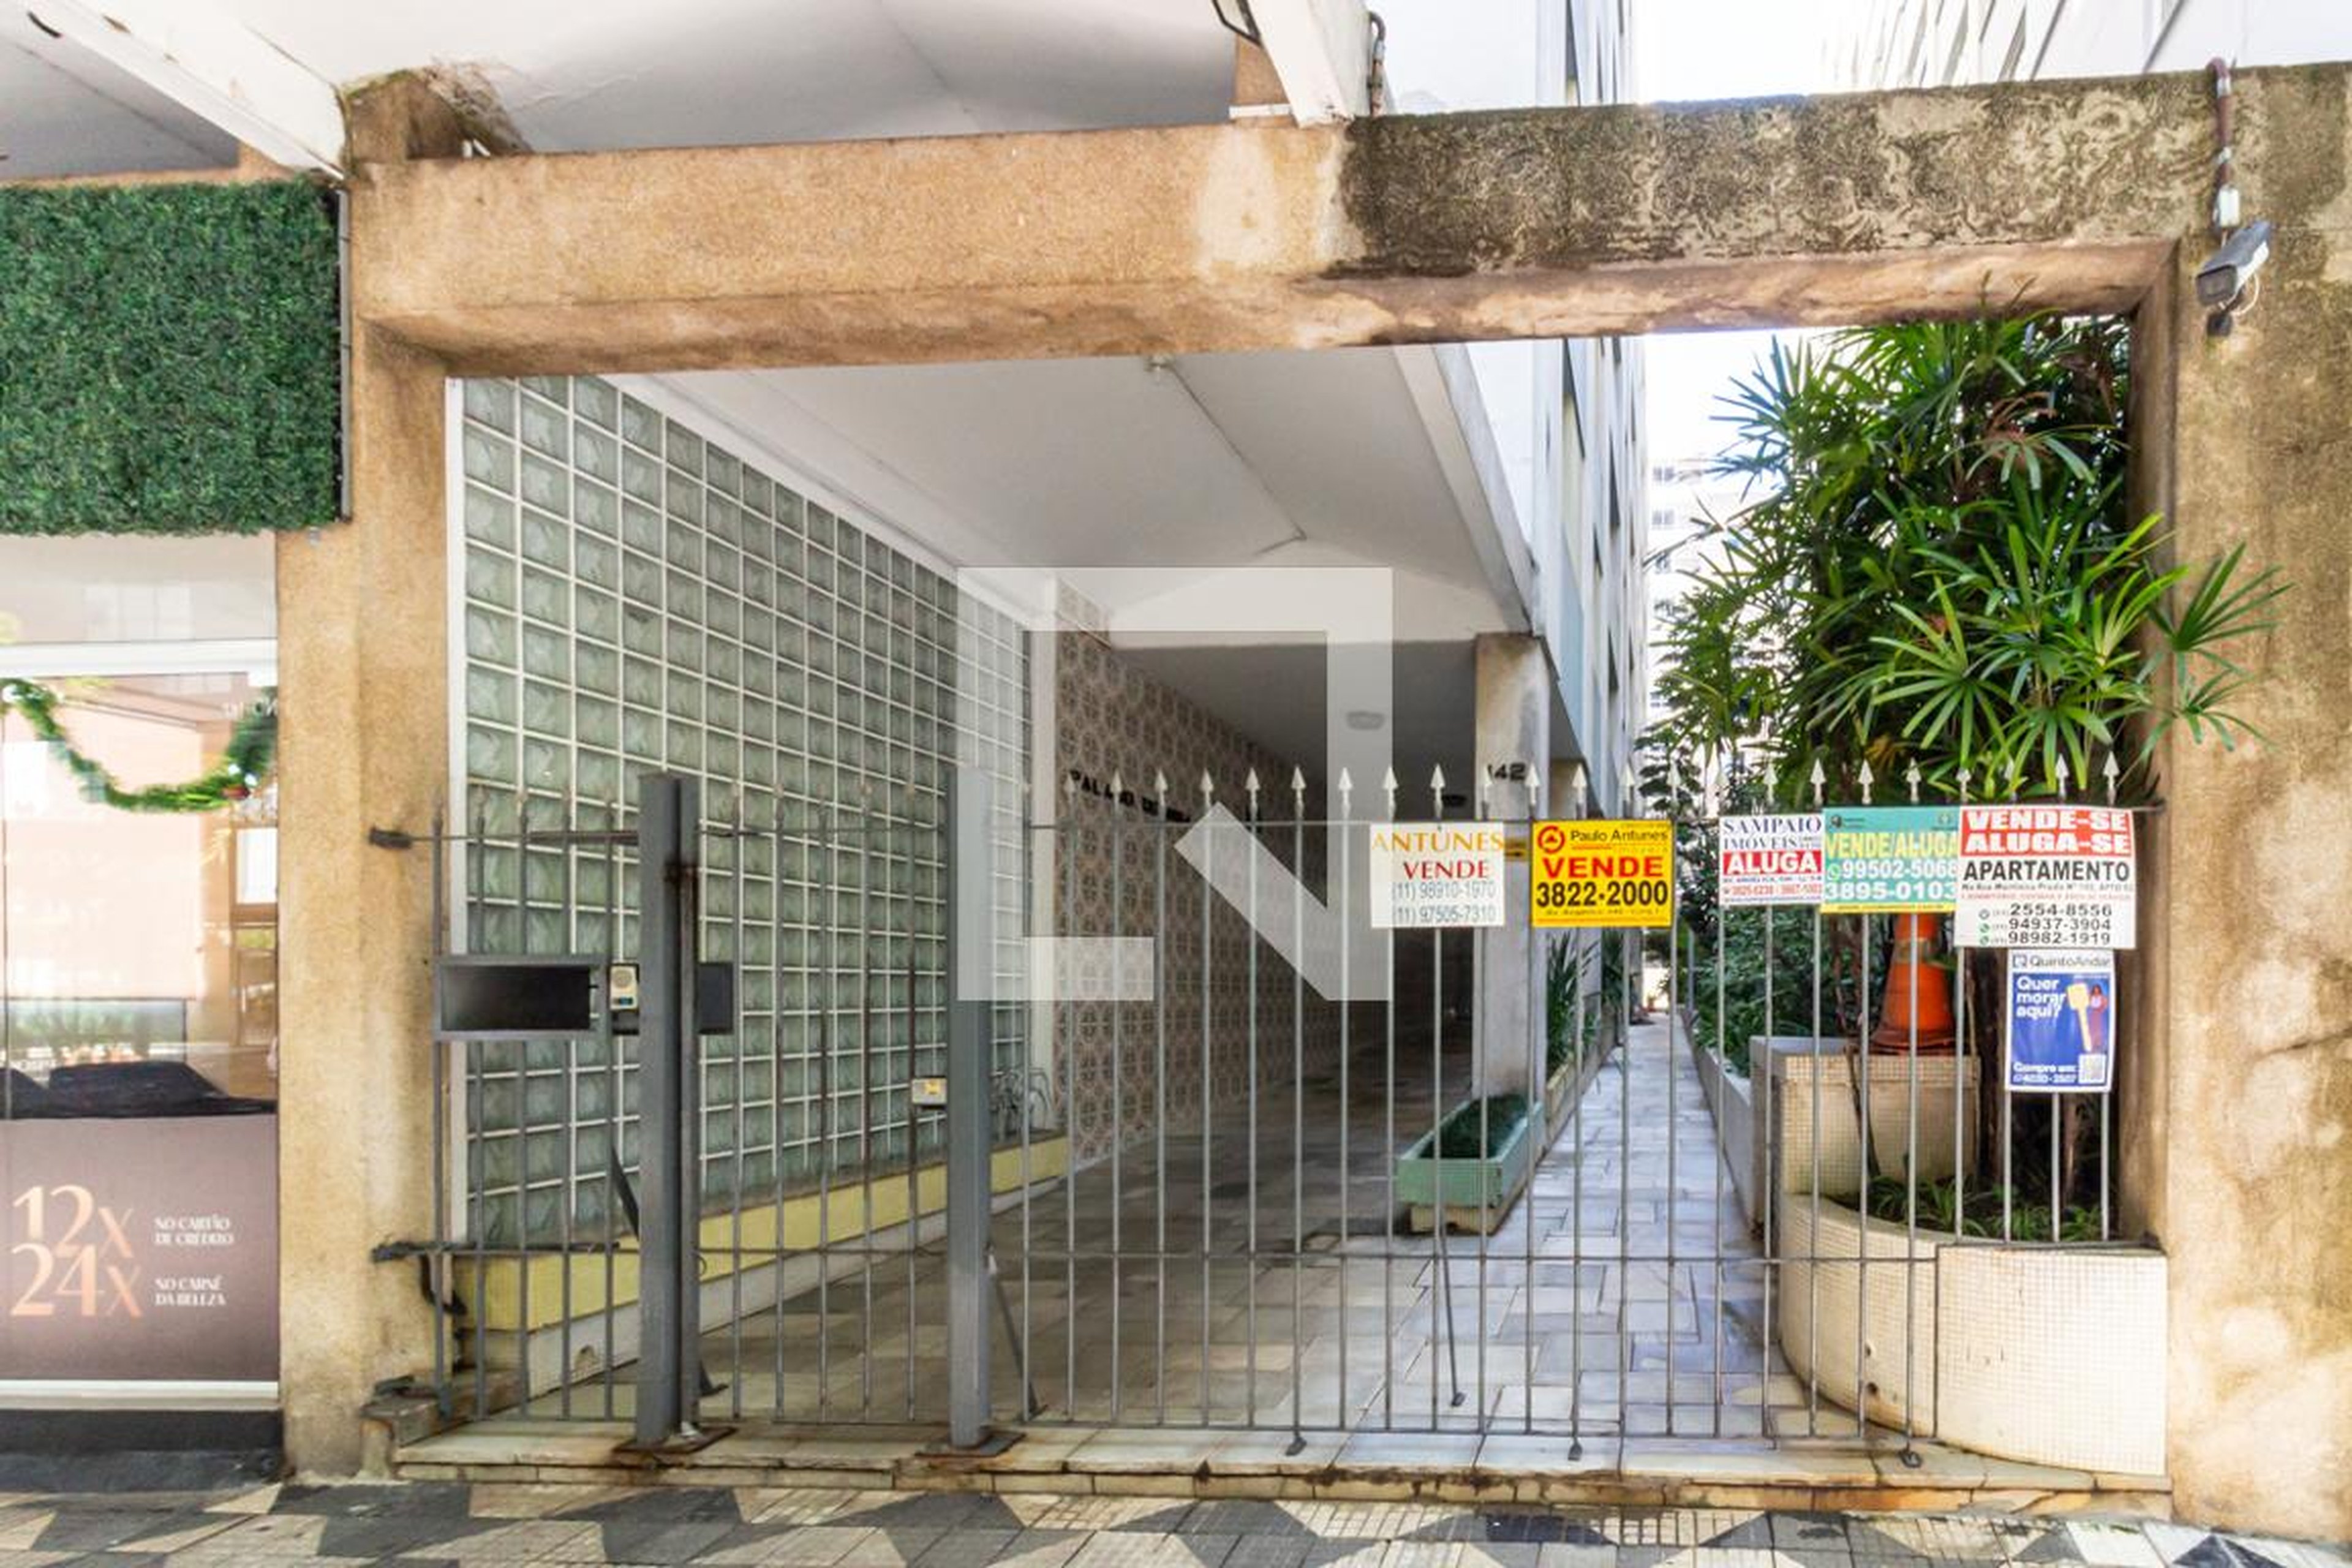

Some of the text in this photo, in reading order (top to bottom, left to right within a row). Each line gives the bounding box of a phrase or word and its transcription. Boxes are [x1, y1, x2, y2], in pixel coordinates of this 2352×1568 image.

[1724, 817, 1822, 834] SAMPAIO
[1967, 810, 2127, 831] VENDE-SE
[1372, 831, 1503, 851] ANTUNES
[1571, 829, 1668, 841] Paulo Antunes
[1965, 832, 2131, 853] ALUGA-SE
[1403, 859, 1490, 880] VENDE
[1542, 856, 1663, 879] VENDE
[1727, 851, 1818, 875] ALUGA
[1963, 860, 2130, 881] APARTAMENTO
[2016, 975, 2059, 991] Quer
[2016, 993, 2067, 1005] morar
